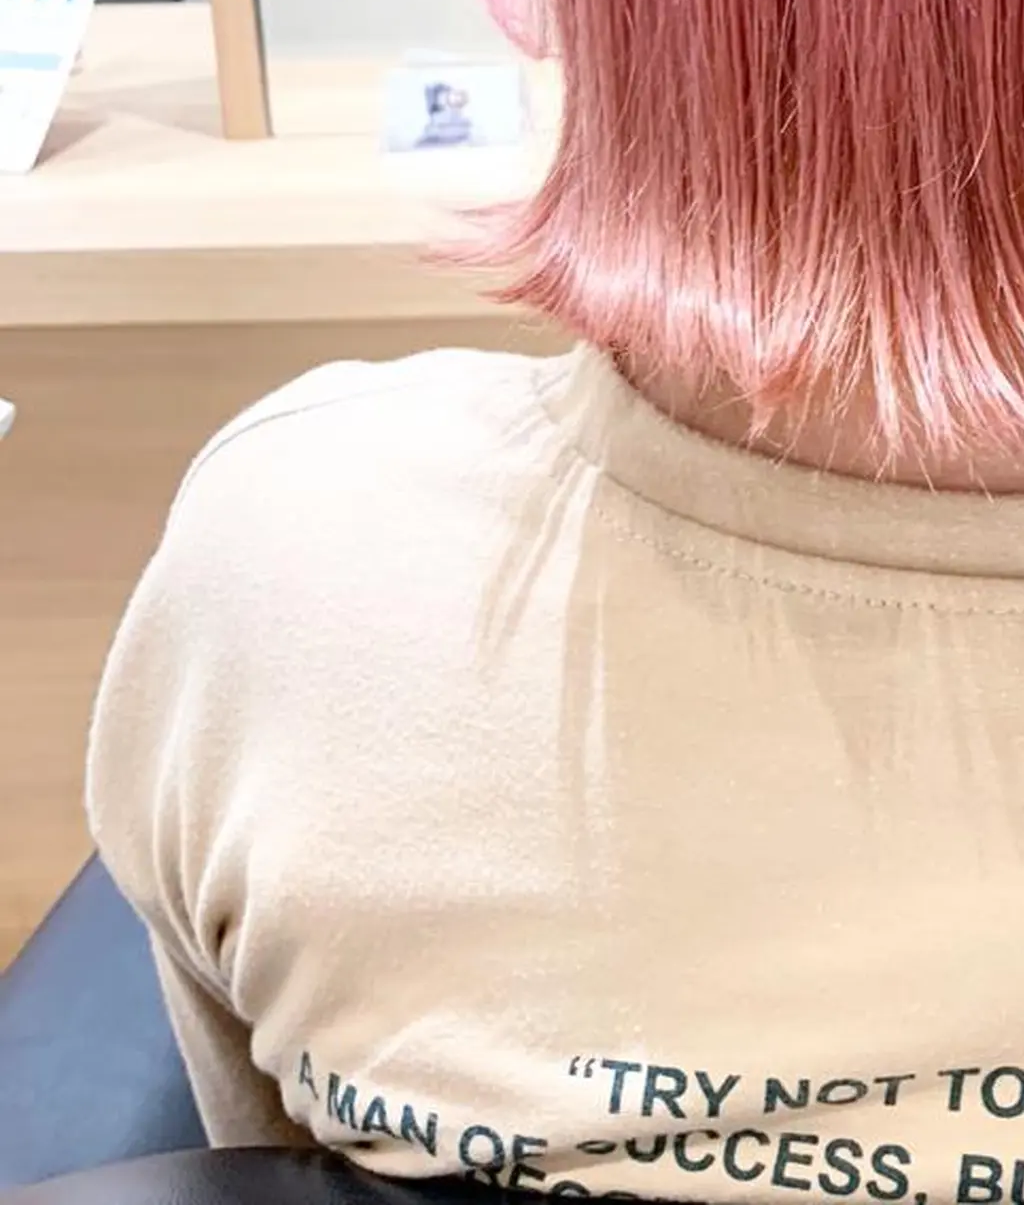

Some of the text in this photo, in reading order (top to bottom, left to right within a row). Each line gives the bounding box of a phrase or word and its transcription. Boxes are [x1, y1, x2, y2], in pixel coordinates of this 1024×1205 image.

[299, 1050, 320, 1100] A
[327, 1071, 439, 1157] MAN
[459, 1124, 550, 1174] OF
[763, 1073, 916, 1108] NOT
